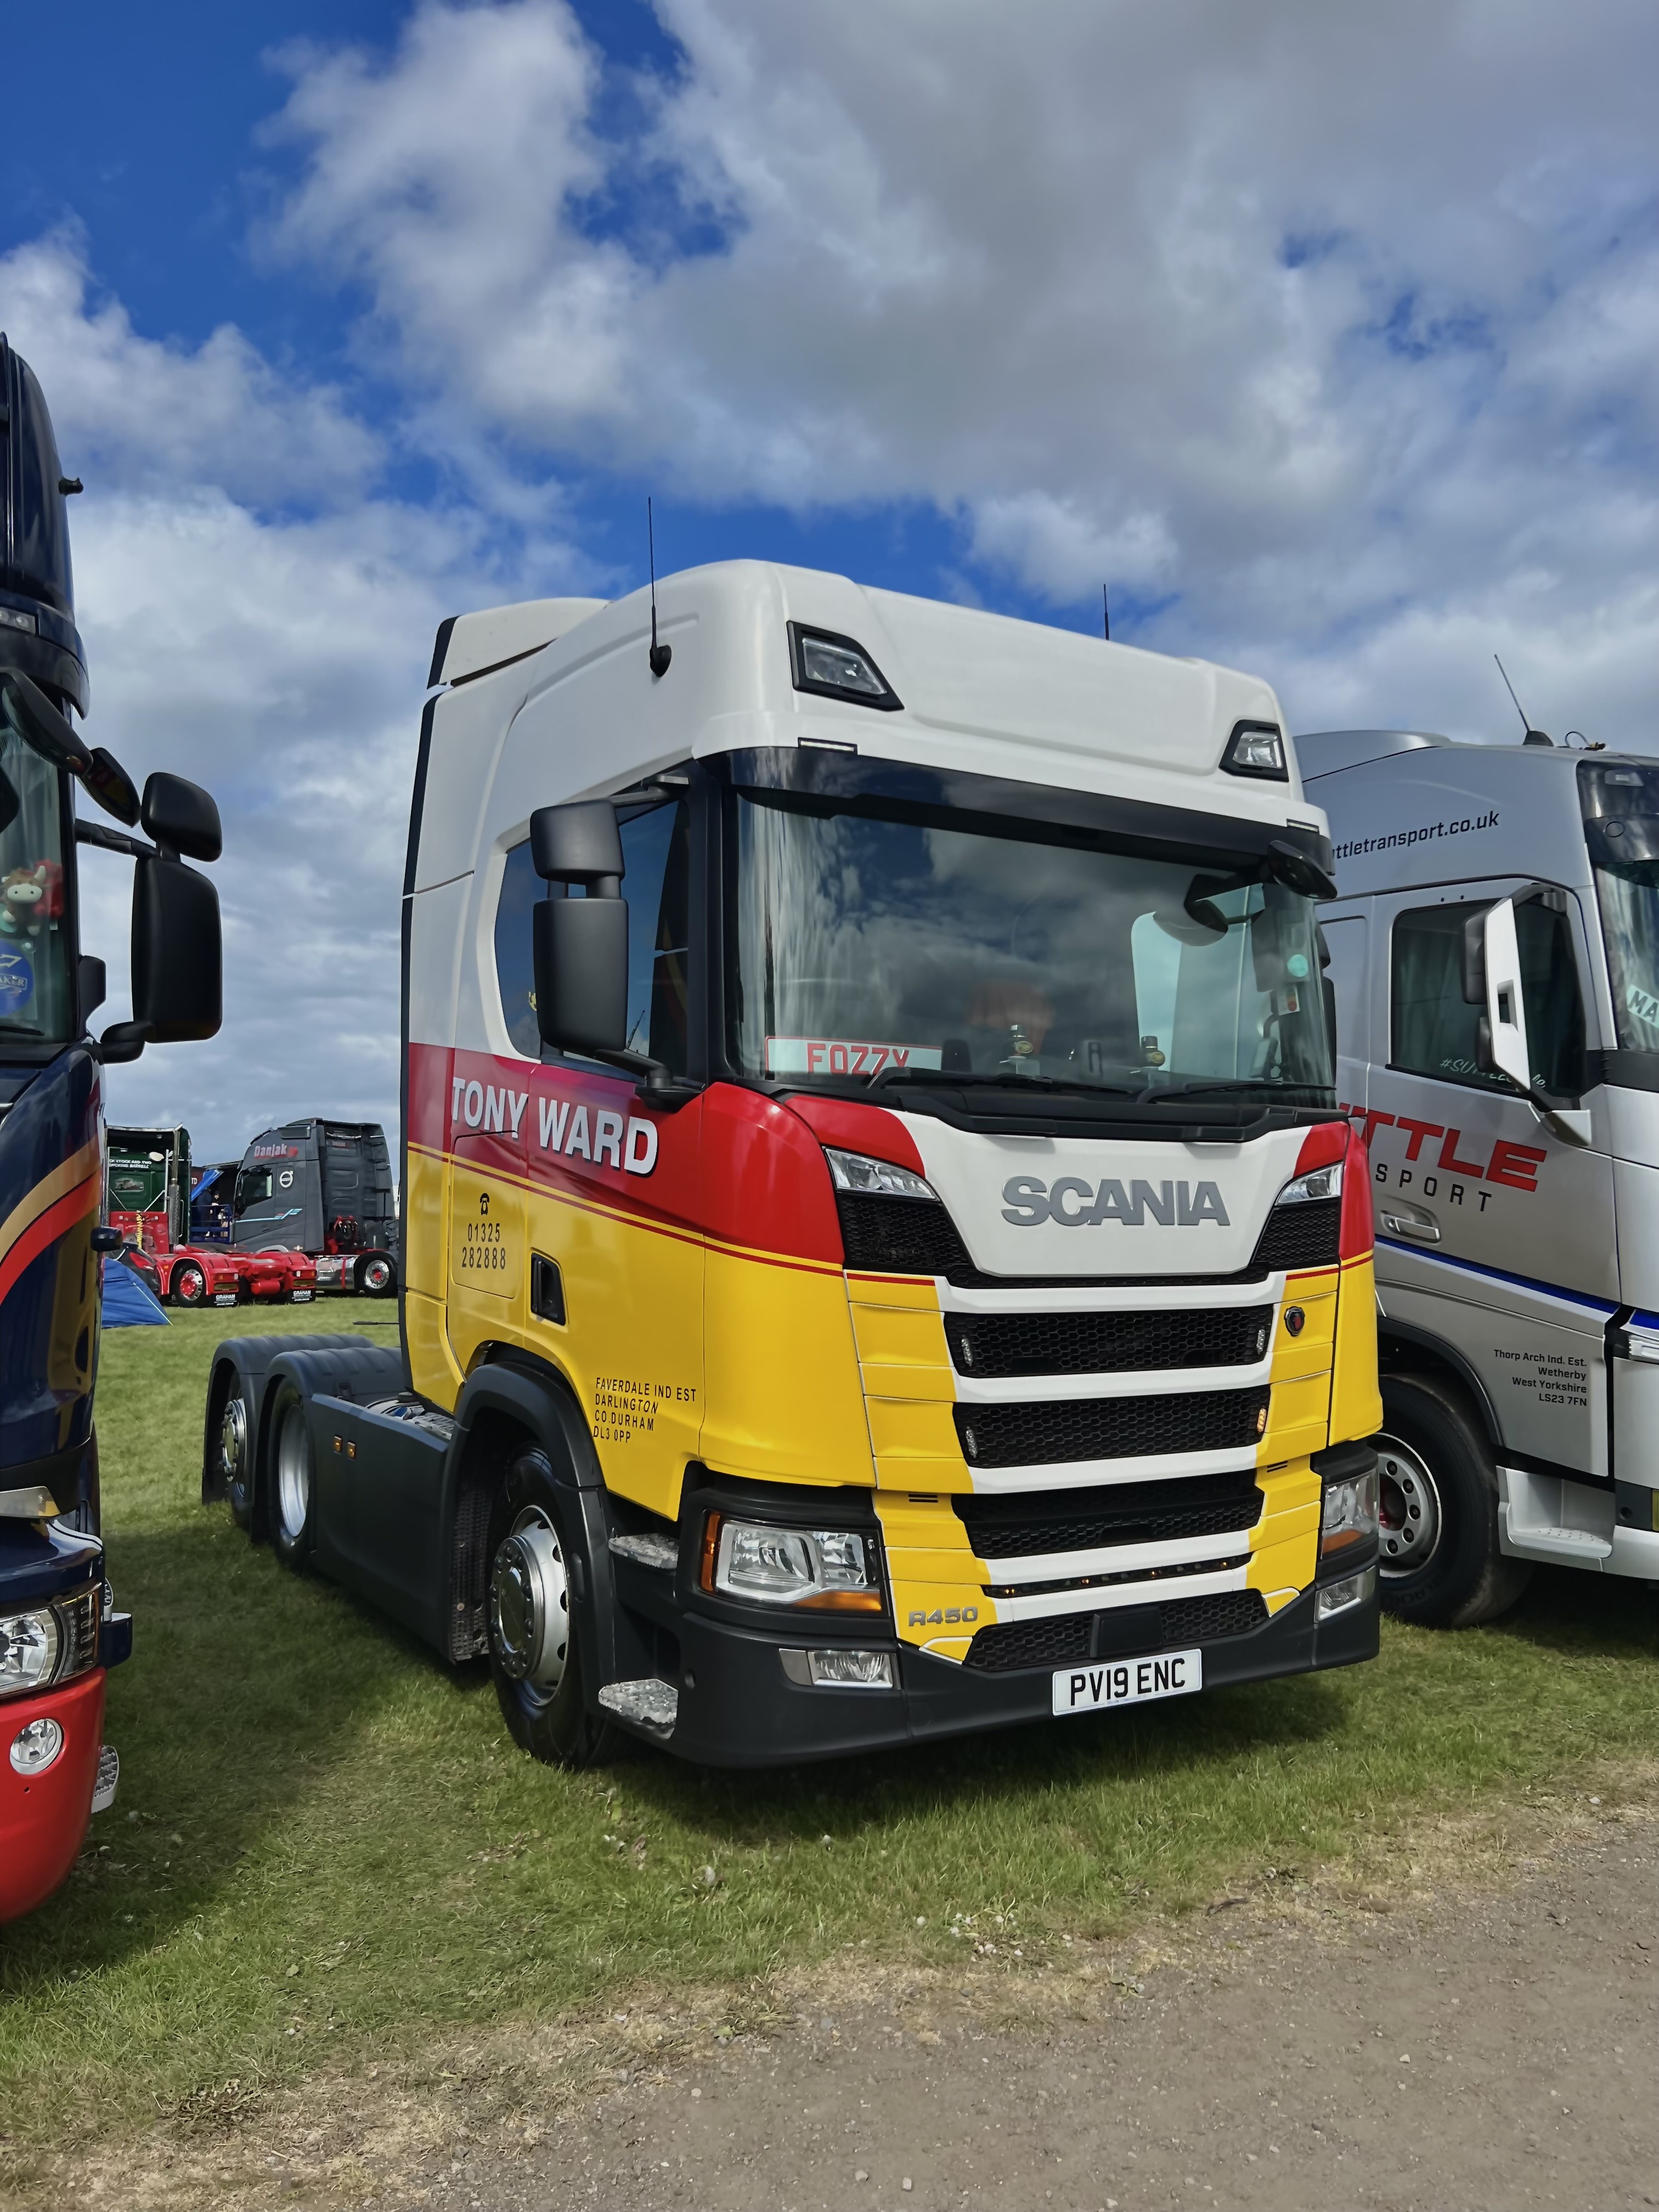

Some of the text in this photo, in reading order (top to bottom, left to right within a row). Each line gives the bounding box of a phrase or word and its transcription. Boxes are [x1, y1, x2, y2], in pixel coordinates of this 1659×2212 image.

[1332, 811, 1499, 860] ttletransport.co.uk
[807, 1043, 910, 1075] FOZZY
[453, 1076, 658, 1175] TONY WARD
[1339, 1102, 1547, 1192] TTLE
[1375, 1163, 1492, 1211] SPORT
[1001, 1176, 1231, 1227] SCANIA
[468, 1222, 500, 1243] 01325
[461, 1246, 506, 1270] 282888
[1494, 1349, 1587, 1367] Thorp Arch Ind. Est.
[1512, 1376, 1587, 1393] West Yorkshire
[1538, 1367, 1587, 1381] Wetherby
[596, 1377, 696, 1402] FAVERDALE IND EST
[1539, 1393, 1587, 1407] LS23 7FN
[595, 1393, 659, 1414] DARLINGTON
[593, 1425, 610, 1440] DL3
[909, 1606, 978, 1627] R450
[1070, 1658, 1186, 1706] PV19 ENC
